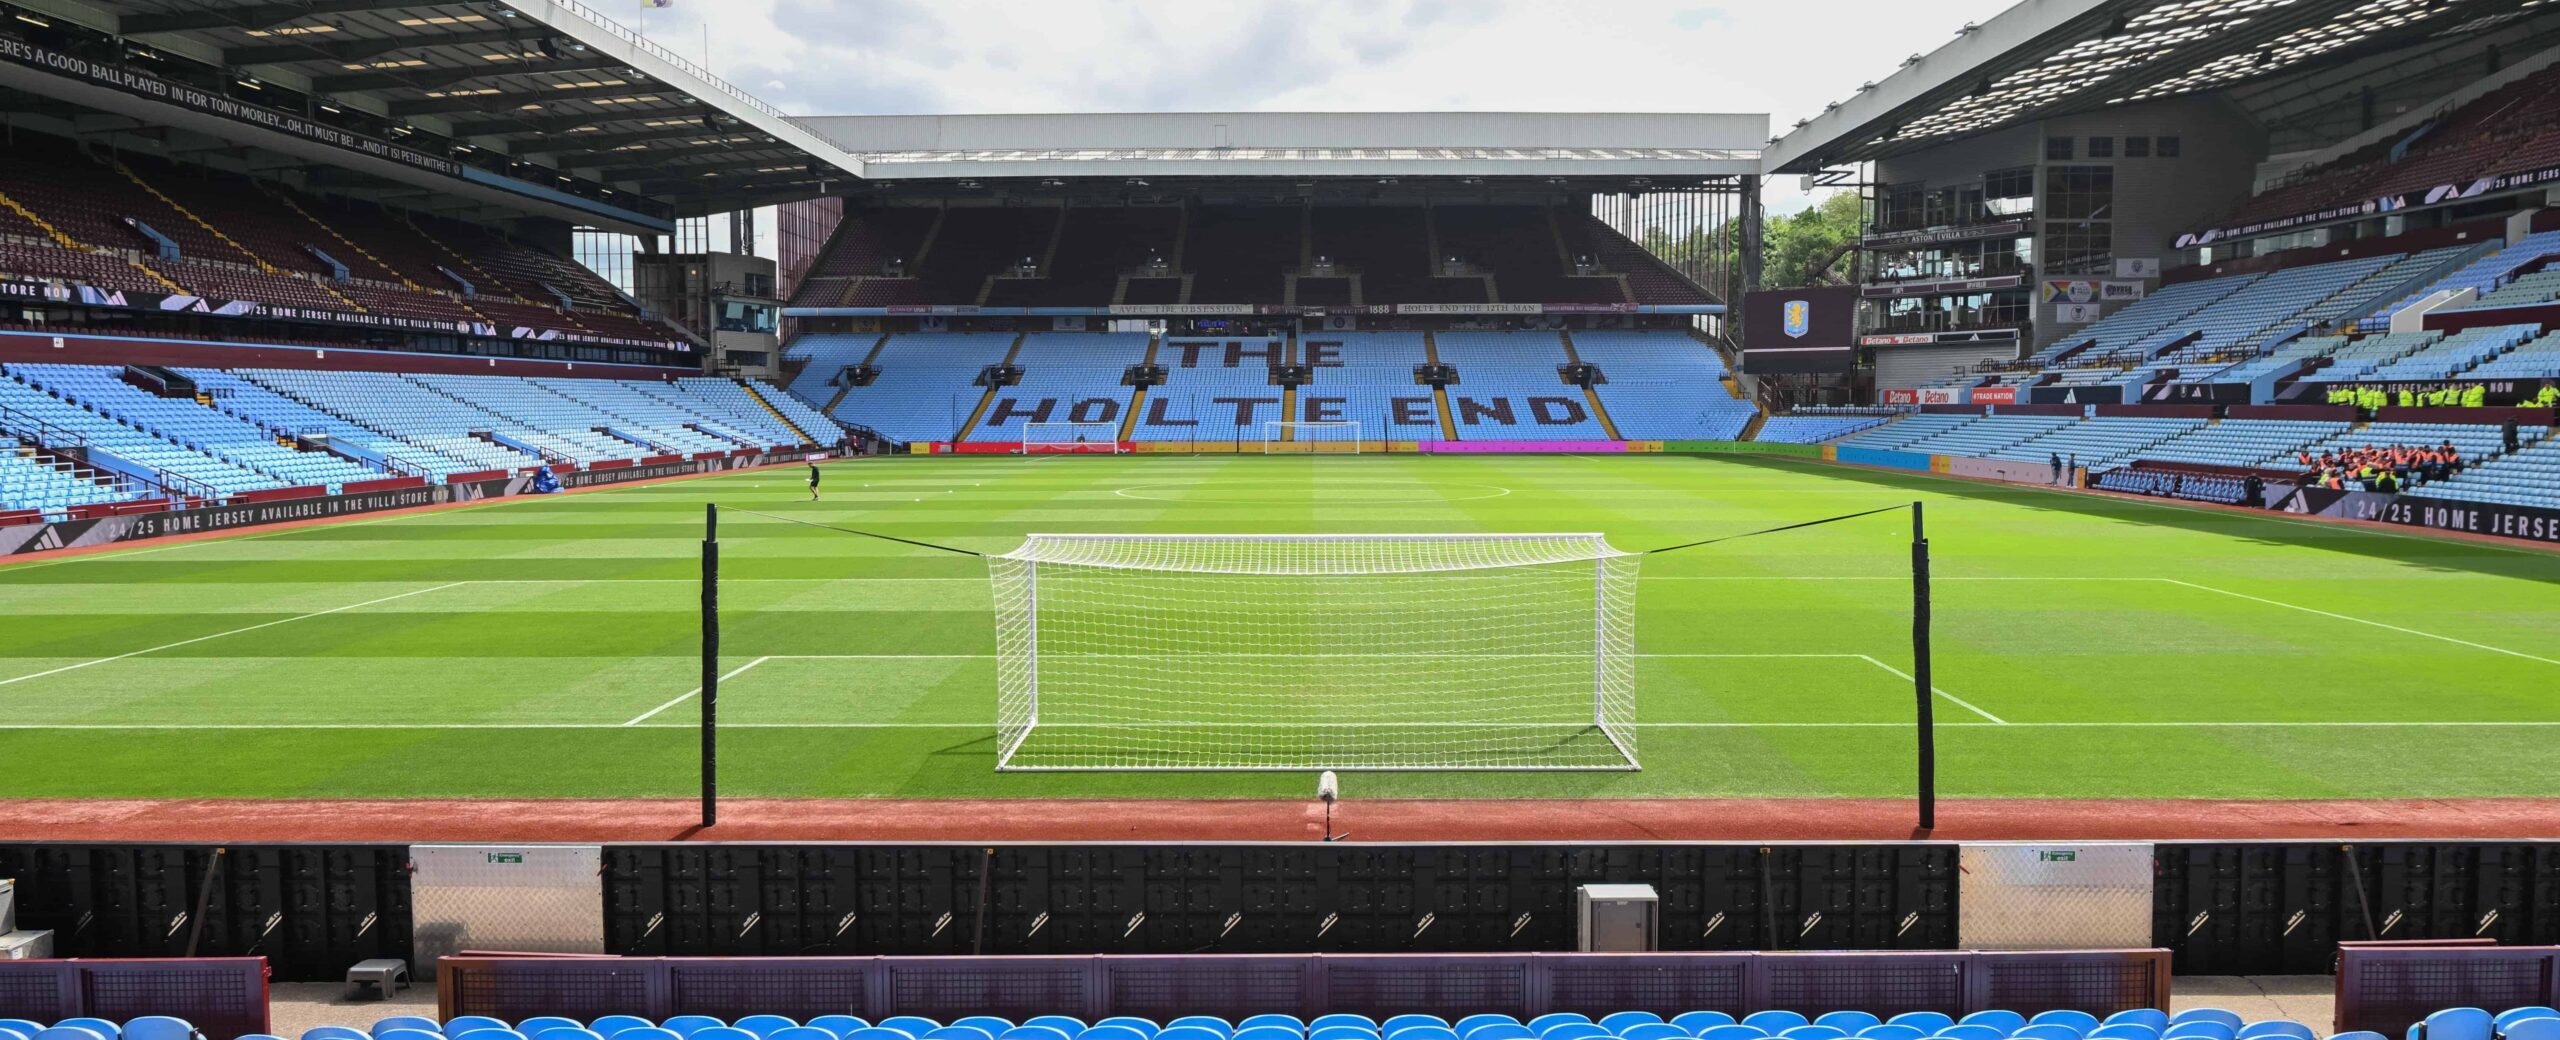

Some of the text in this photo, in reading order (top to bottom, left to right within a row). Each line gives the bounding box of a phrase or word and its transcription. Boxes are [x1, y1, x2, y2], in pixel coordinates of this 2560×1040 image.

[35, 49, 45, 64] A
[48, 53, 87, 75] GOOD
[92, 64, 122, 85] BALL
[124, 73, 167, 96] PLAYED
[172, 86, 183, 101] IN
[186, 91, 207, 108] FOR
[210, 97, 238, 116] TONY
[315, 127, 338, 143] MUST
[341, 134, 354, 147] BE!
[401, 151, 423, 164] PETER
[2510, 173, 2533, 185] HOME
[2242, 224, 2262, 234] JERSEY
[2264, 219, 2294, 230] AVAILABLE
[2296, 216, 2303, 224] IN
[2305, 214, 2316, 222] THE
[2319, 210, 2336, 220] VILLA
[2339, 206, 2359, 216] STORE
[1912, 231, 1960, 243] ASTON VILLA
[44, 287, 71, 298] NOW
[1181, 305, 1243, 313] OBSESSION
[1369, 305, 1389, 314] 1888
[1463, 304, 1481, 312] THE
[1487, 304, 1508, 312] 12TH
[1513, 304, 1535, 312] MAN
[238, 304, 267, 316] 24/25
[272, 307, 297, 317] HOME
[301, 309, 332, 320] JERSEY
[336, 312, 379, 325] AVAILABLE
[382, 316, 390, 325] IN
[394, 318, 407, 327] THE
[410, 319, 430, 328] VILLA
[433, 321, 454, 331] STORE
[582, 335, 599, 343] JERSEY
[601, 337, 624, 345] AVAILABLE
[1867, 336, 1928, 345] Betano Betano
[1167, 342, 1345, 368] THE
[2490, 382, 2513, 393] NOW
[1889, 390, 1949, 403] Betano Betano
[1994, 391, 2013, 400] NATION
[986, 397, 1588, 426] HOLTE END
[576, 475, 592, 485] HOME
[595, 472, 616, 482] JERSEY
[617, 469, 646, 480] AVAILABLE
[647, 468, 654, 476] IN
[655, 467, 665, 476] THE
[666, 465, 680, 475] VILLA
[681, 463, 695, 472] STORE
[110, 489, 449, 539] 24/25 HOME JERSEY AVAILABLE IN THE VILLA STORE NOW
[2358, 501, 2559, 539] 24/25 HOME JERSE
